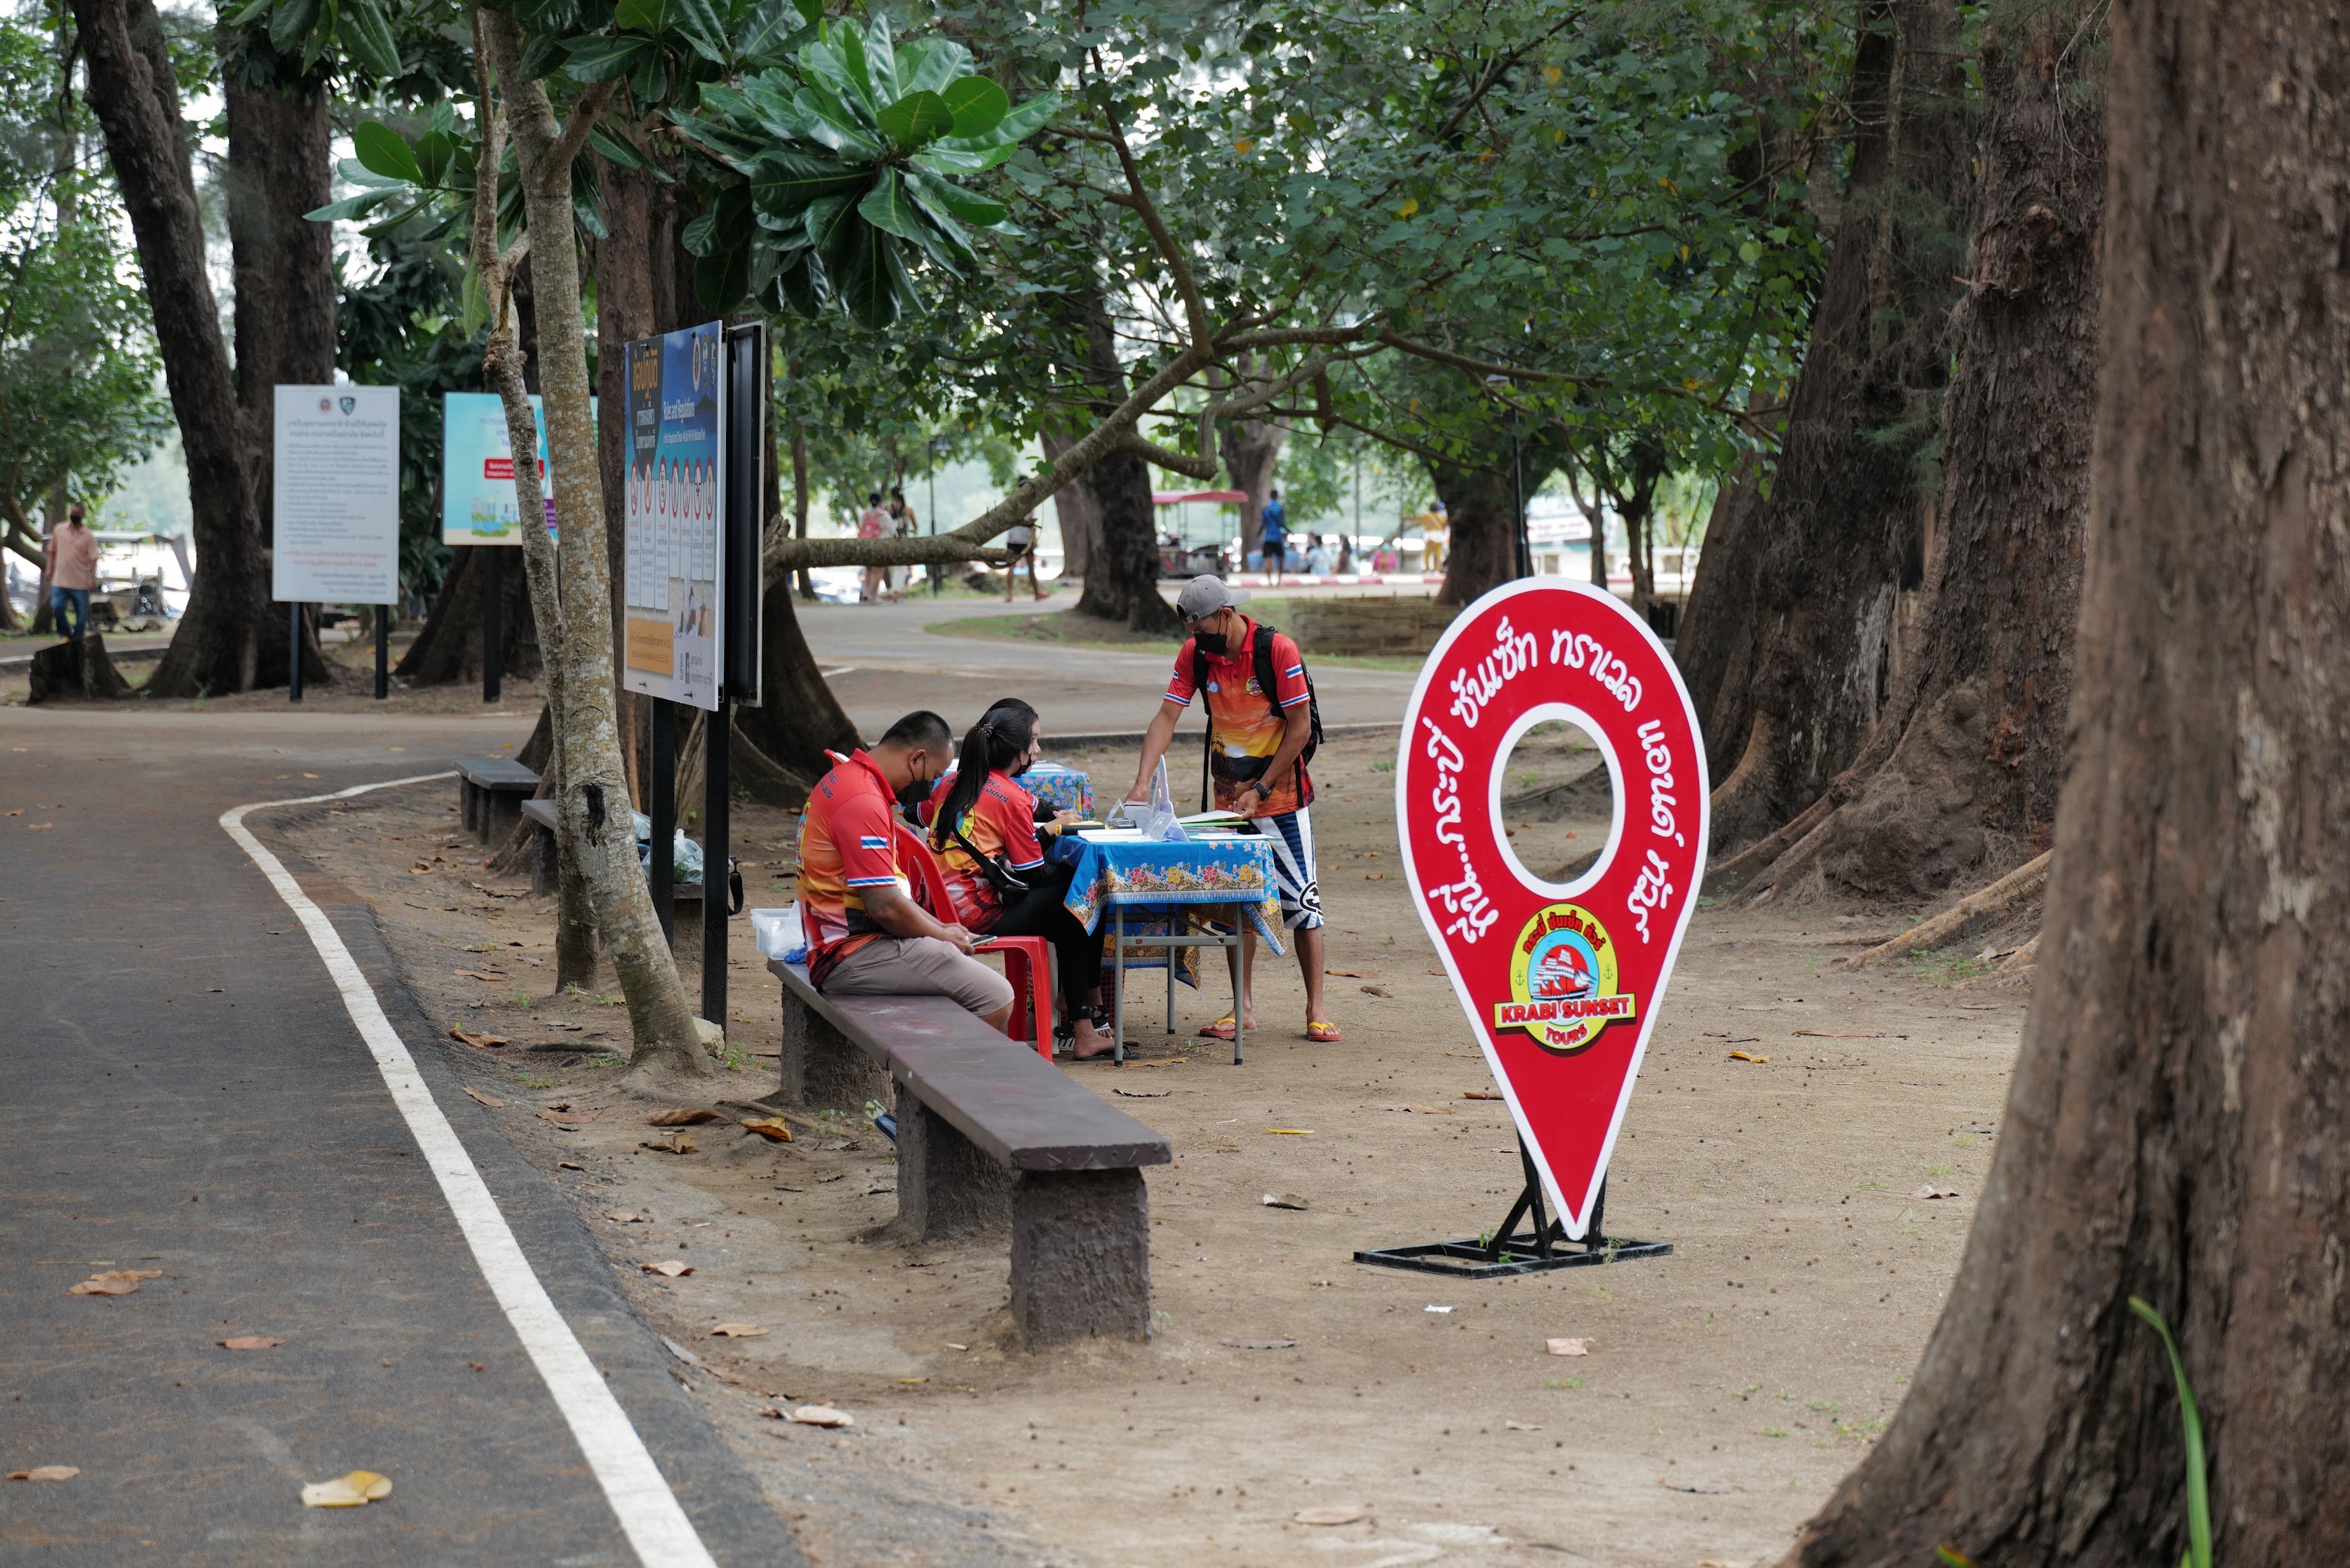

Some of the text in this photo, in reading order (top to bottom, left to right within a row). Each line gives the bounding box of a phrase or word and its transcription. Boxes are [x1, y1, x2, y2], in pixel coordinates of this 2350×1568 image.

[1449, 615, 1538, 728] ซันเซ็ท
[1549, 629, 1643, 713] ทราเวล
[1636, 719, 1685, 848] แอนด์
[1522, 909, 1607, 955] กระบี่ ซันเซ็ท ทัวร์
[1627, 848, 1674, 944] ทัวร์
[1500, 997, 1630, 1024] KRABI SUNSET
[1545, 1023, 1588, 1046] TOURS
